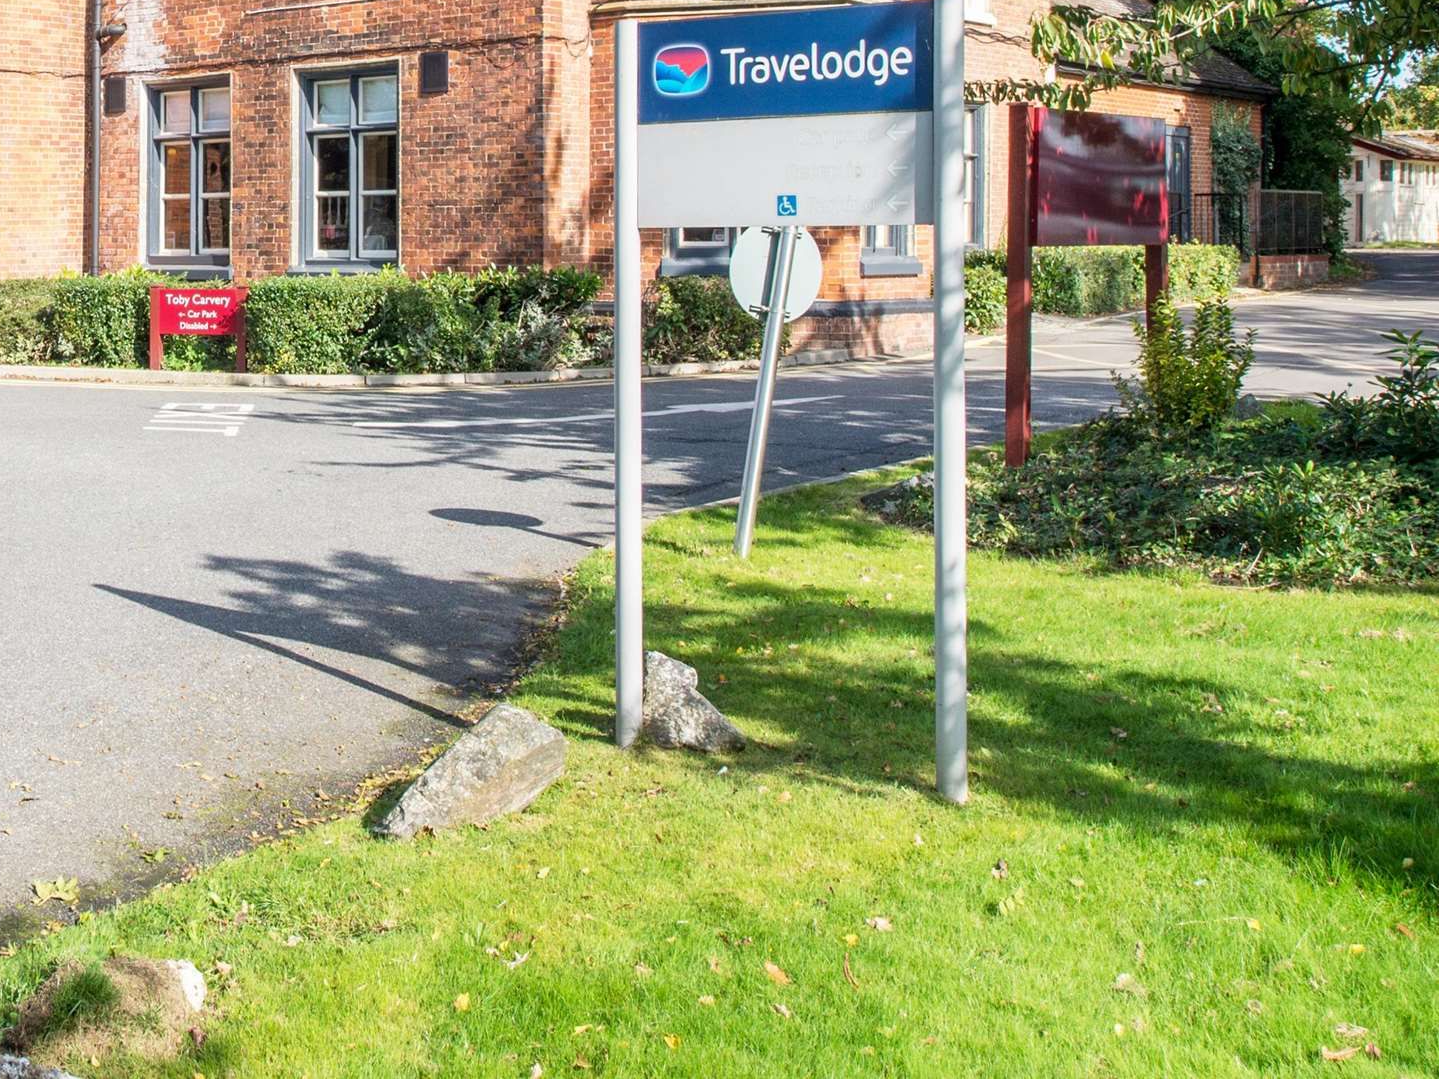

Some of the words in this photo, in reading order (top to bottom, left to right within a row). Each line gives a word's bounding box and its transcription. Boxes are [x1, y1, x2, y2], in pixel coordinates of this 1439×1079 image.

[720, 38, 913, 87] Travelodge
[165, 293, 190, 308] Toby
[191, 293, 231, 308] Carvery
[187, 309, 200, 318] Car
[201, 309, 217, 318] Park
[179, 321, 209, 330] Disabled
